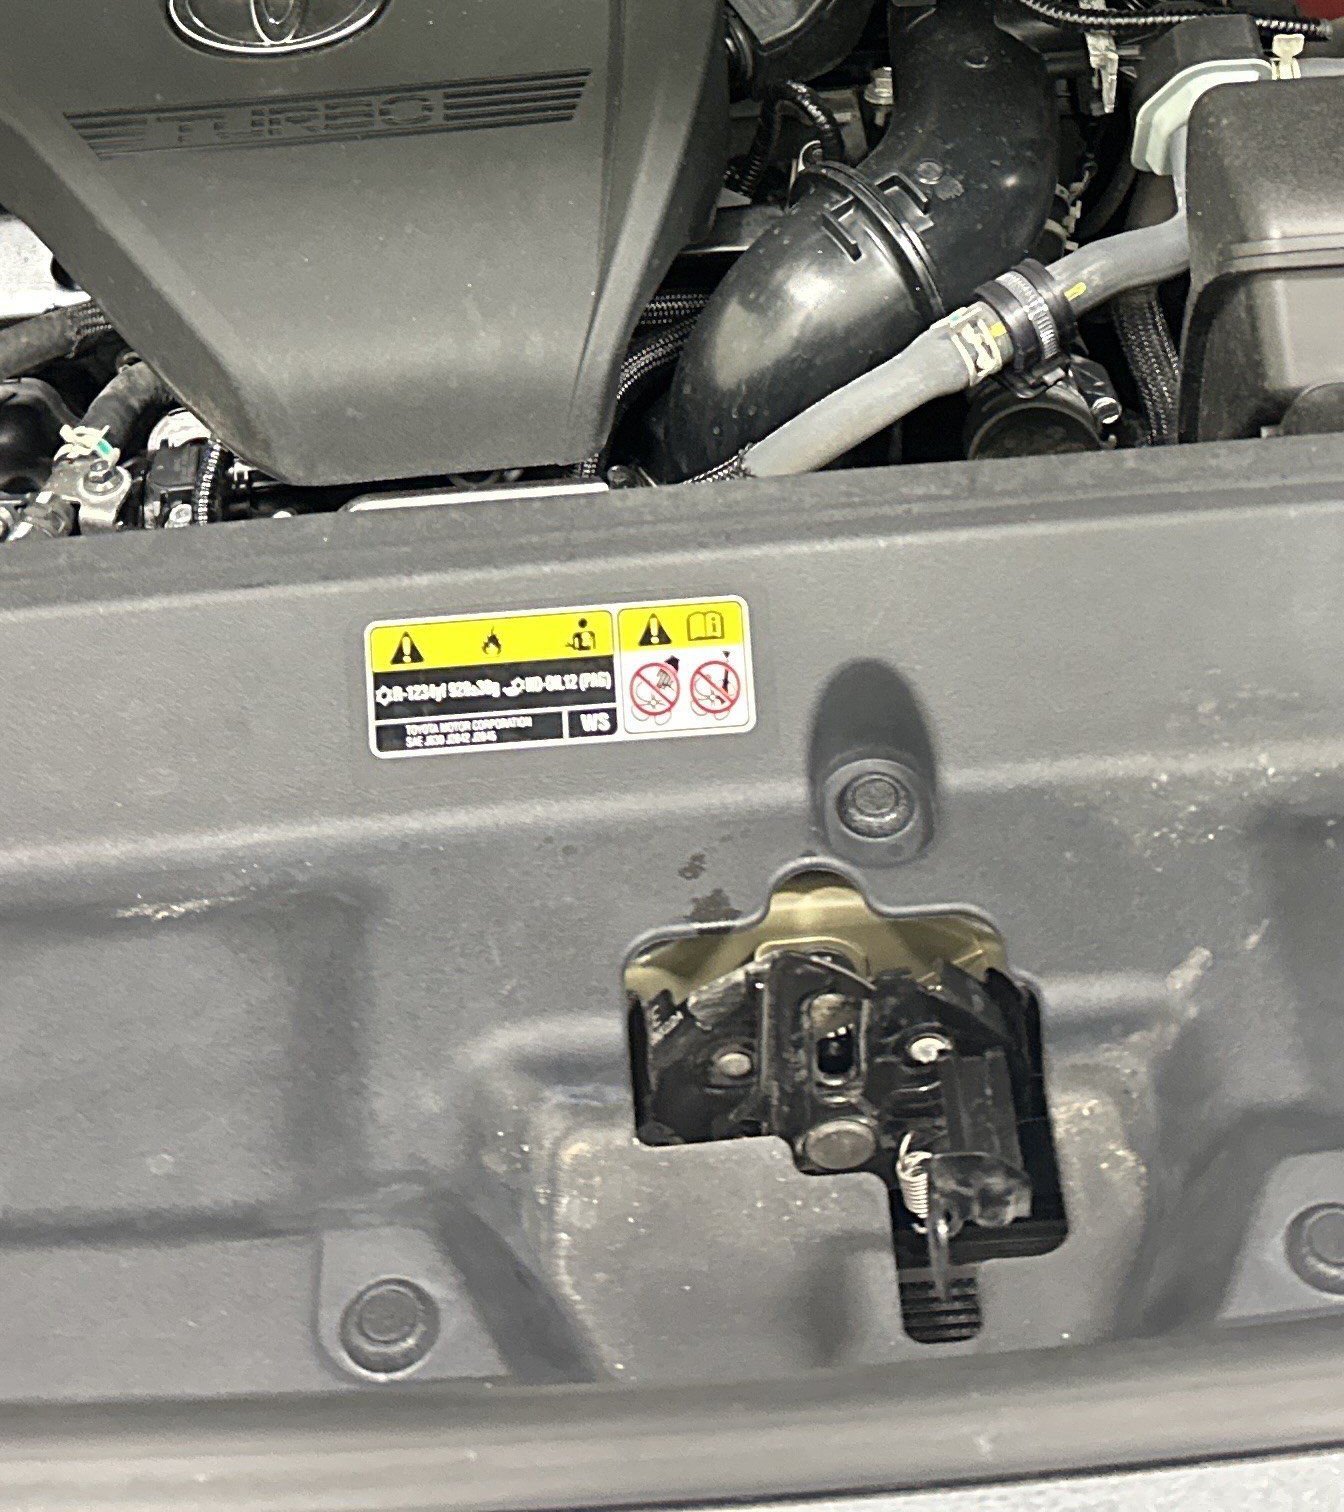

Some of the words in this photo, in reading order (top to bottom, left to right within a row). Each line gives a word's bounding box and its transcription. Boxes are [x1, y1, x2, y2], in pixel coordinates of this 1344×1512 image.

[155, 94, 434, 143] TURBO
[405, 722, 438, 737] TOYOTA
[439, 719, 472, 734] MOTOR
[471, 716, 533, 732] CORPORATION
[579, 711, 612, 733] WS
